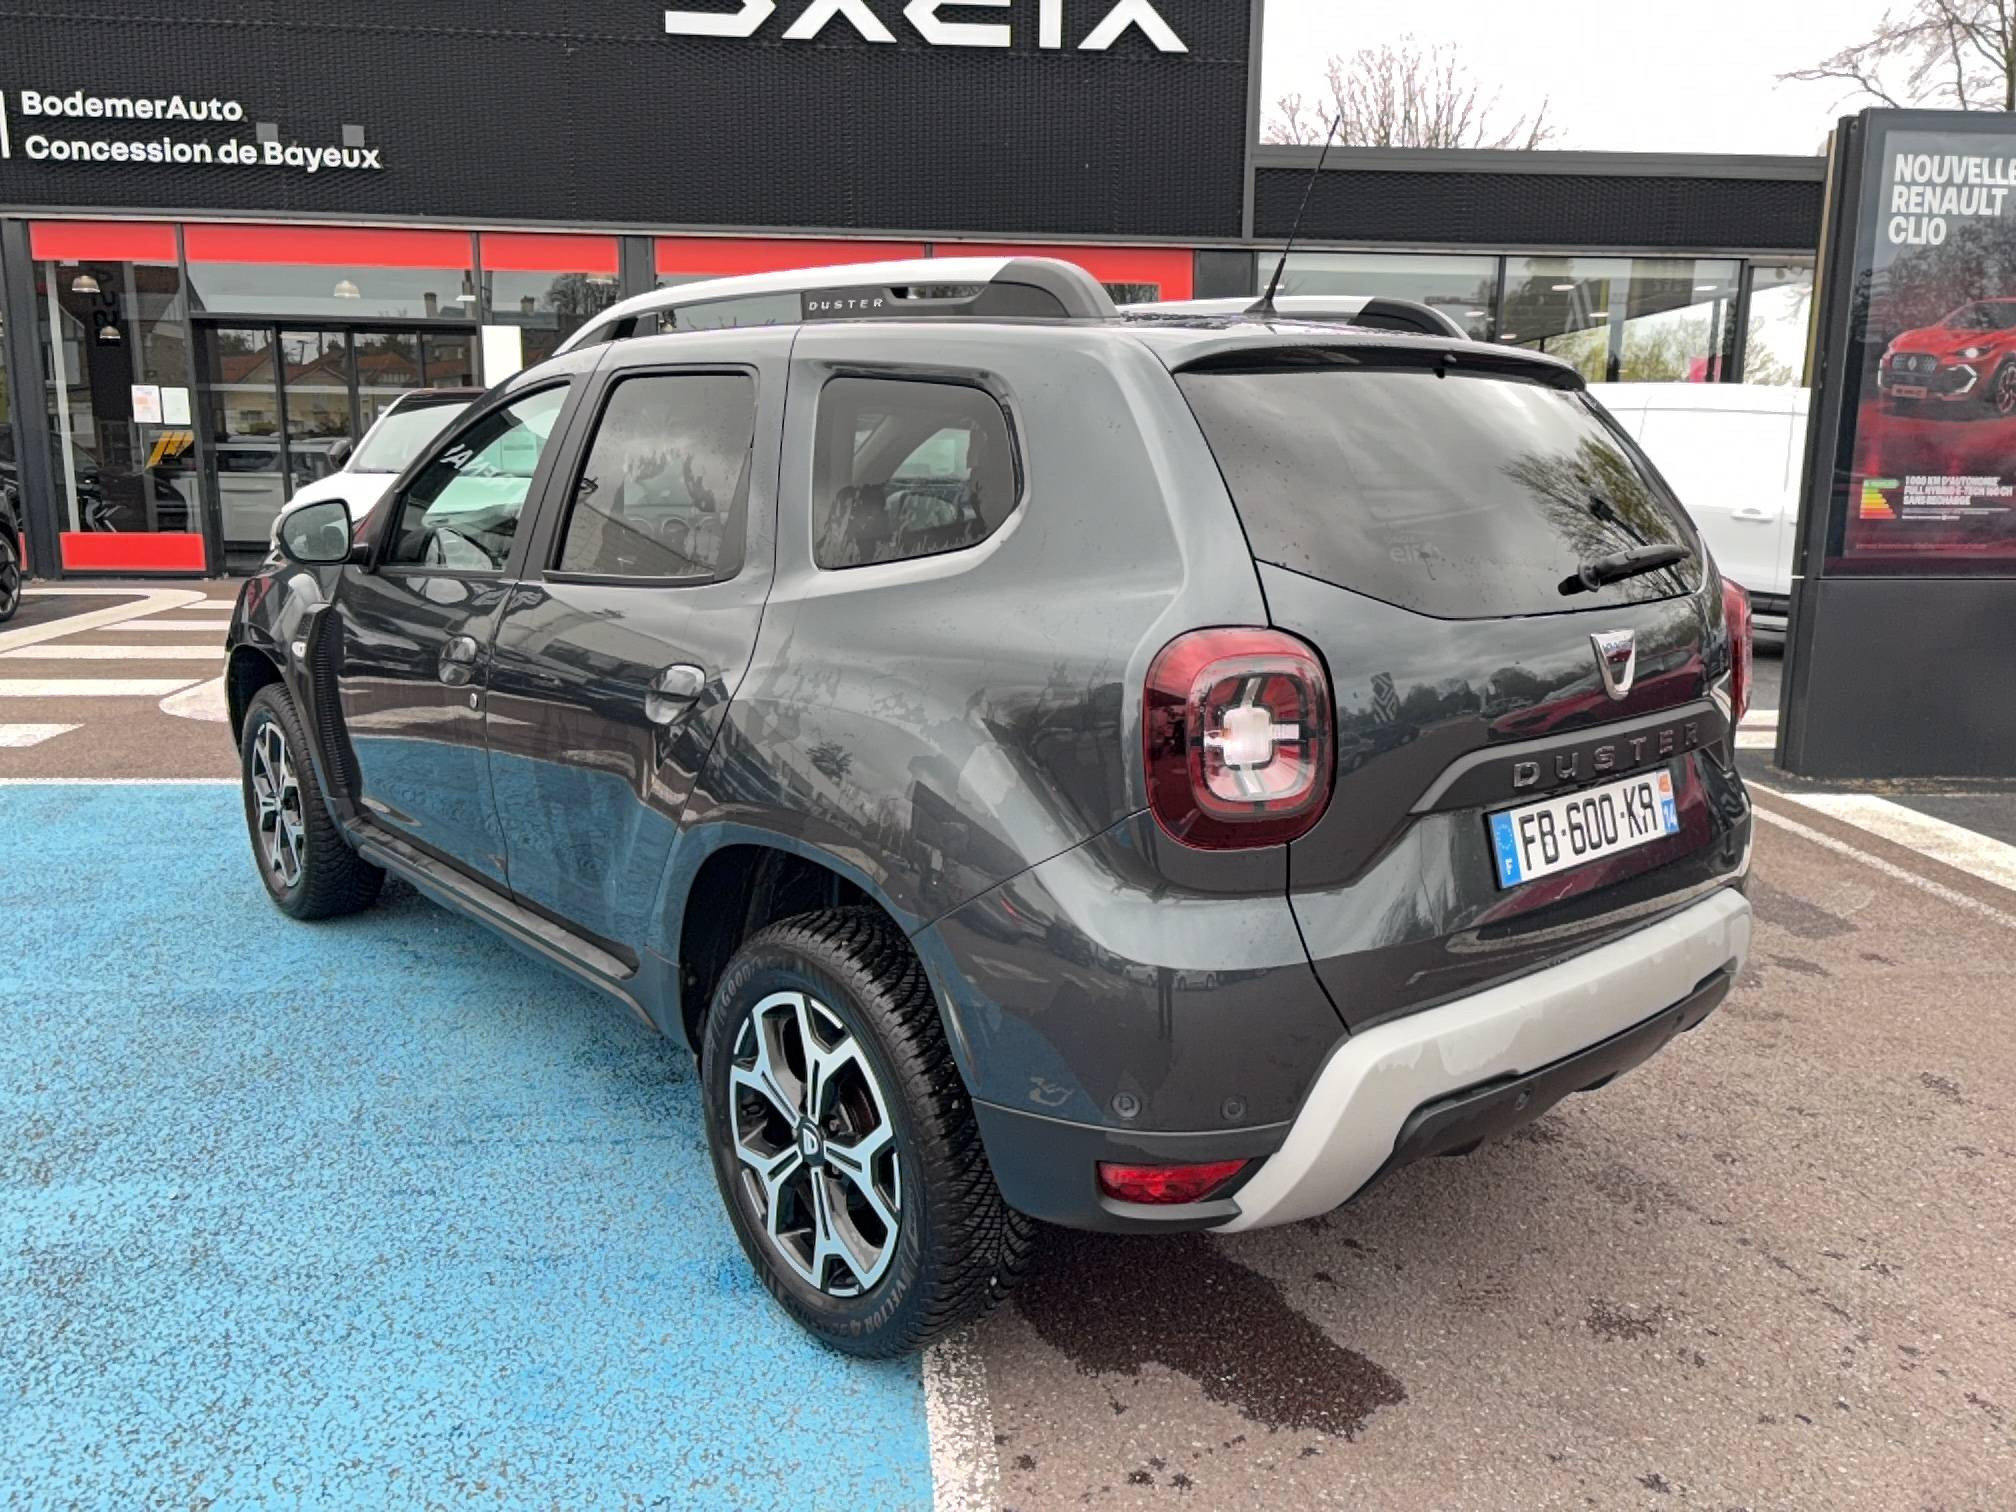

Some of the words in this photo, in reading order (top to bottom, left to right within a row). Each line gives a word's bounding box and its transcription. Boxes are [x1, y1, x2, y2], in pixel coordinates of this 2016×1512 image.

[21, 90, 243, 122] BodemerAuto
[25, 135, 213, 164] Concession
[218, 139, 257, 165] de
[263, 141, 382, 173] Bayeux
[1891, 185, 2008, 216] RENAULT
[1888, 216, 1947, 245] CLIO
[808, 298, 883, 311] DUSTER
[1513, 722, 1698, 788] DUSTER
[1518, 782, 1658, 871] FB-600-KR
